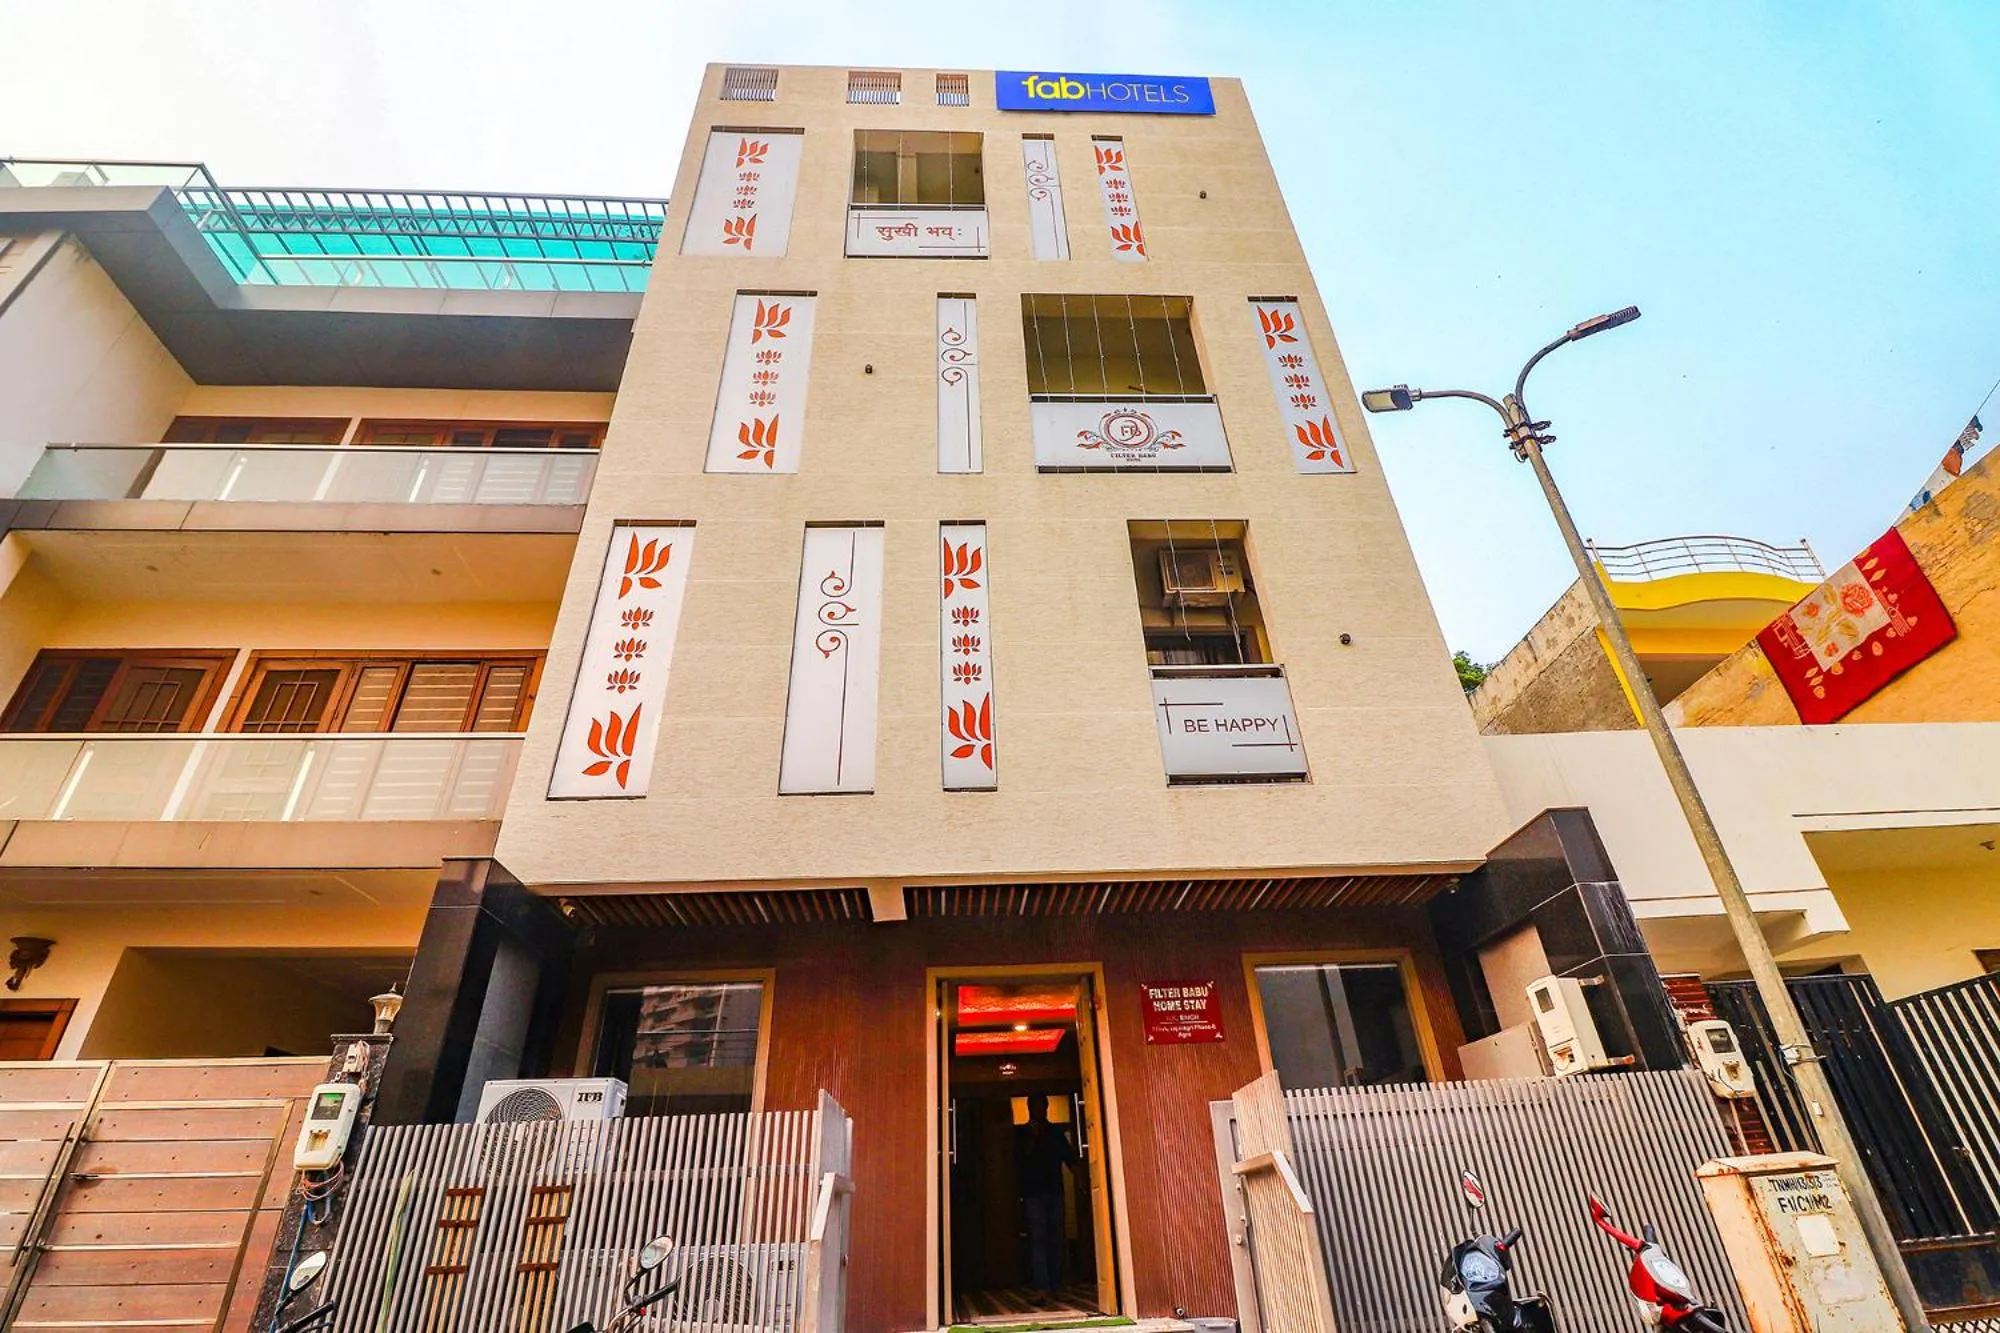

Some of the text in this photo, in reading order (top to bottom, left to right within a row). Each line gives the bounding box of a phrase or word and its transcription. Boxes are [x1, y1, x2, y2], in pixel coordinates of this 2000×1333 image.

[1184, 718, 1279, 733] BE HAPPY
[1148, 985, 1209, 999] FILTER BABU
[1153, 999, 1208, 1012] HOME STAY
[577, 1092, 603, 1102] IFB
